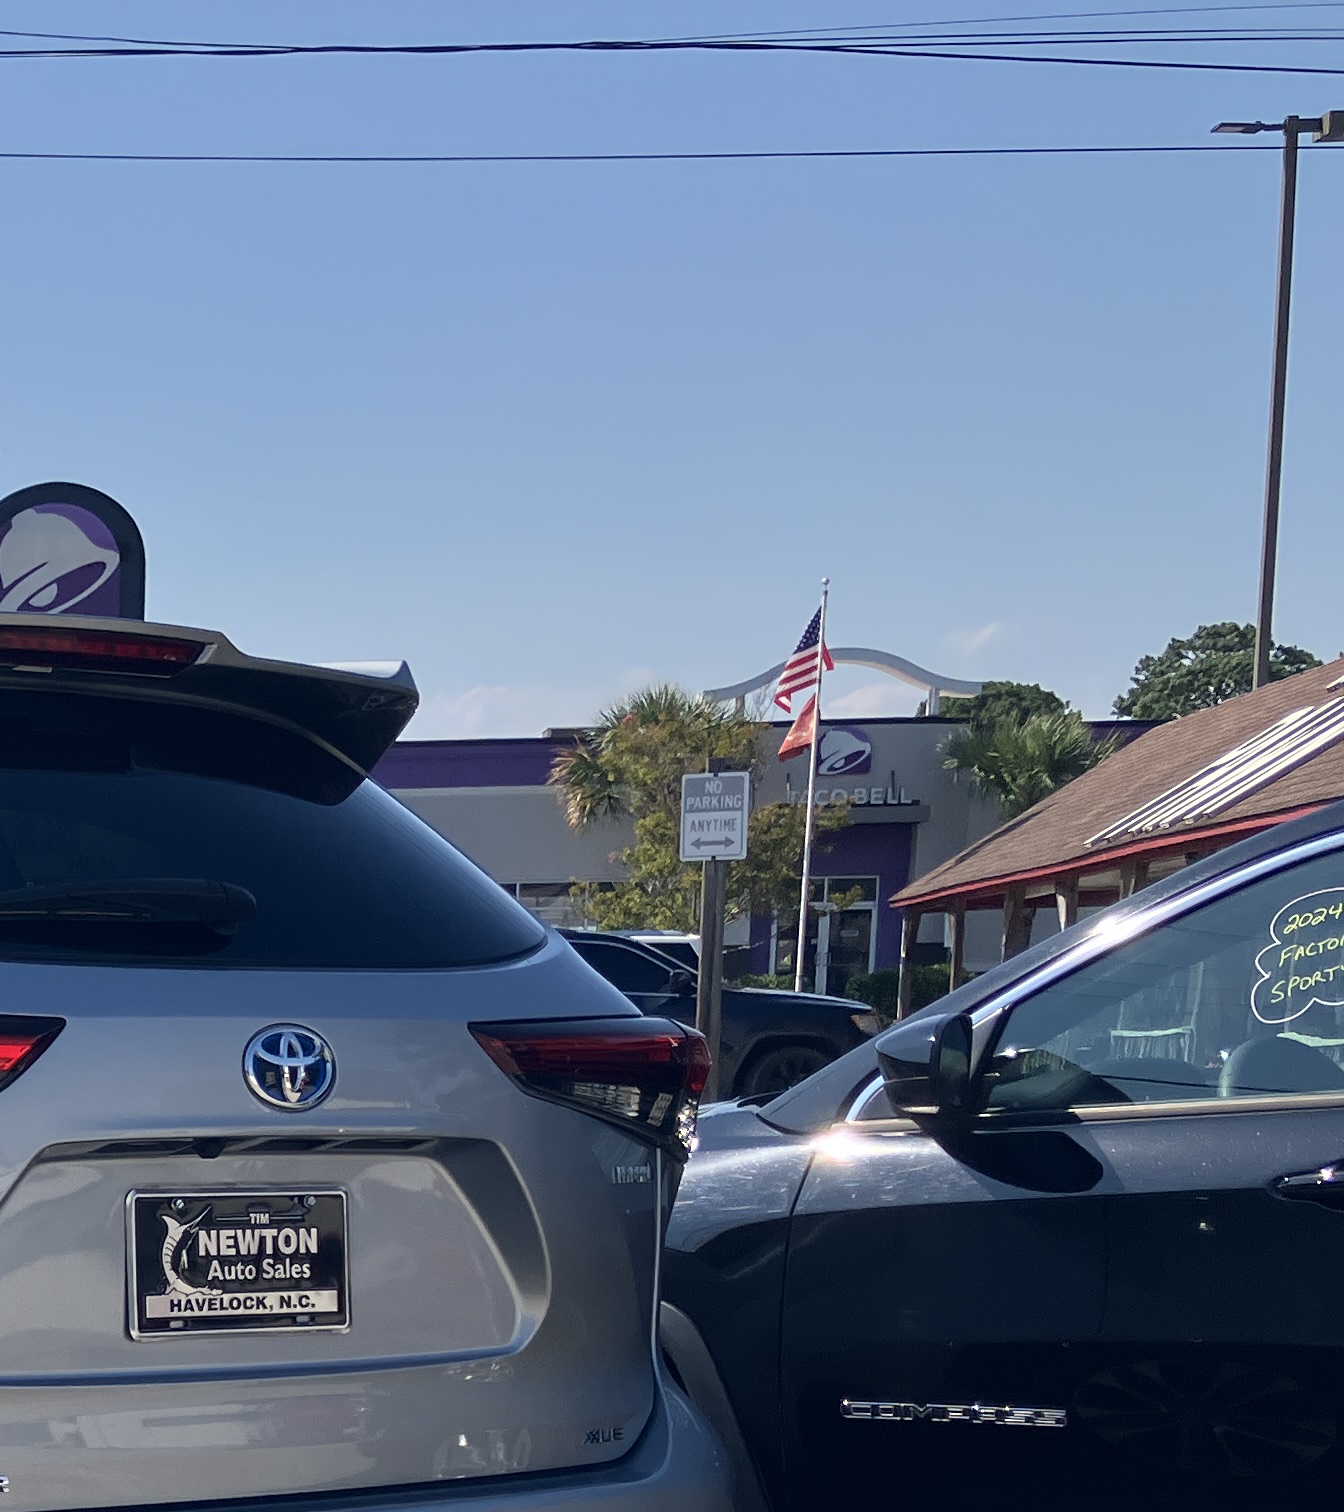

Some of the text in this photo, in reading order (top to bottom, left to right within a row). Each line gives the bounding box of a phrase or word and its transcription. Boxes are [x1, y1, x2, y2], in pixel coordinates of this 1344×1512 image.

[705, 781, 722, 794] NO
[789, 787, 912, 805] TCO BELL
[686, 795, 742, 810] PARKING
[690, 818, 737, 833] ANYTIME
[1283, 902, 1343, 934] 2024
[250, 1213, 270, 1224] TIM
[199, 1228, 318, 1256] NEWTON
[207, 1258, 311, 1281] Auto Sales
[170, 1295, 316, 1313] HAVELOCK, N.C.
